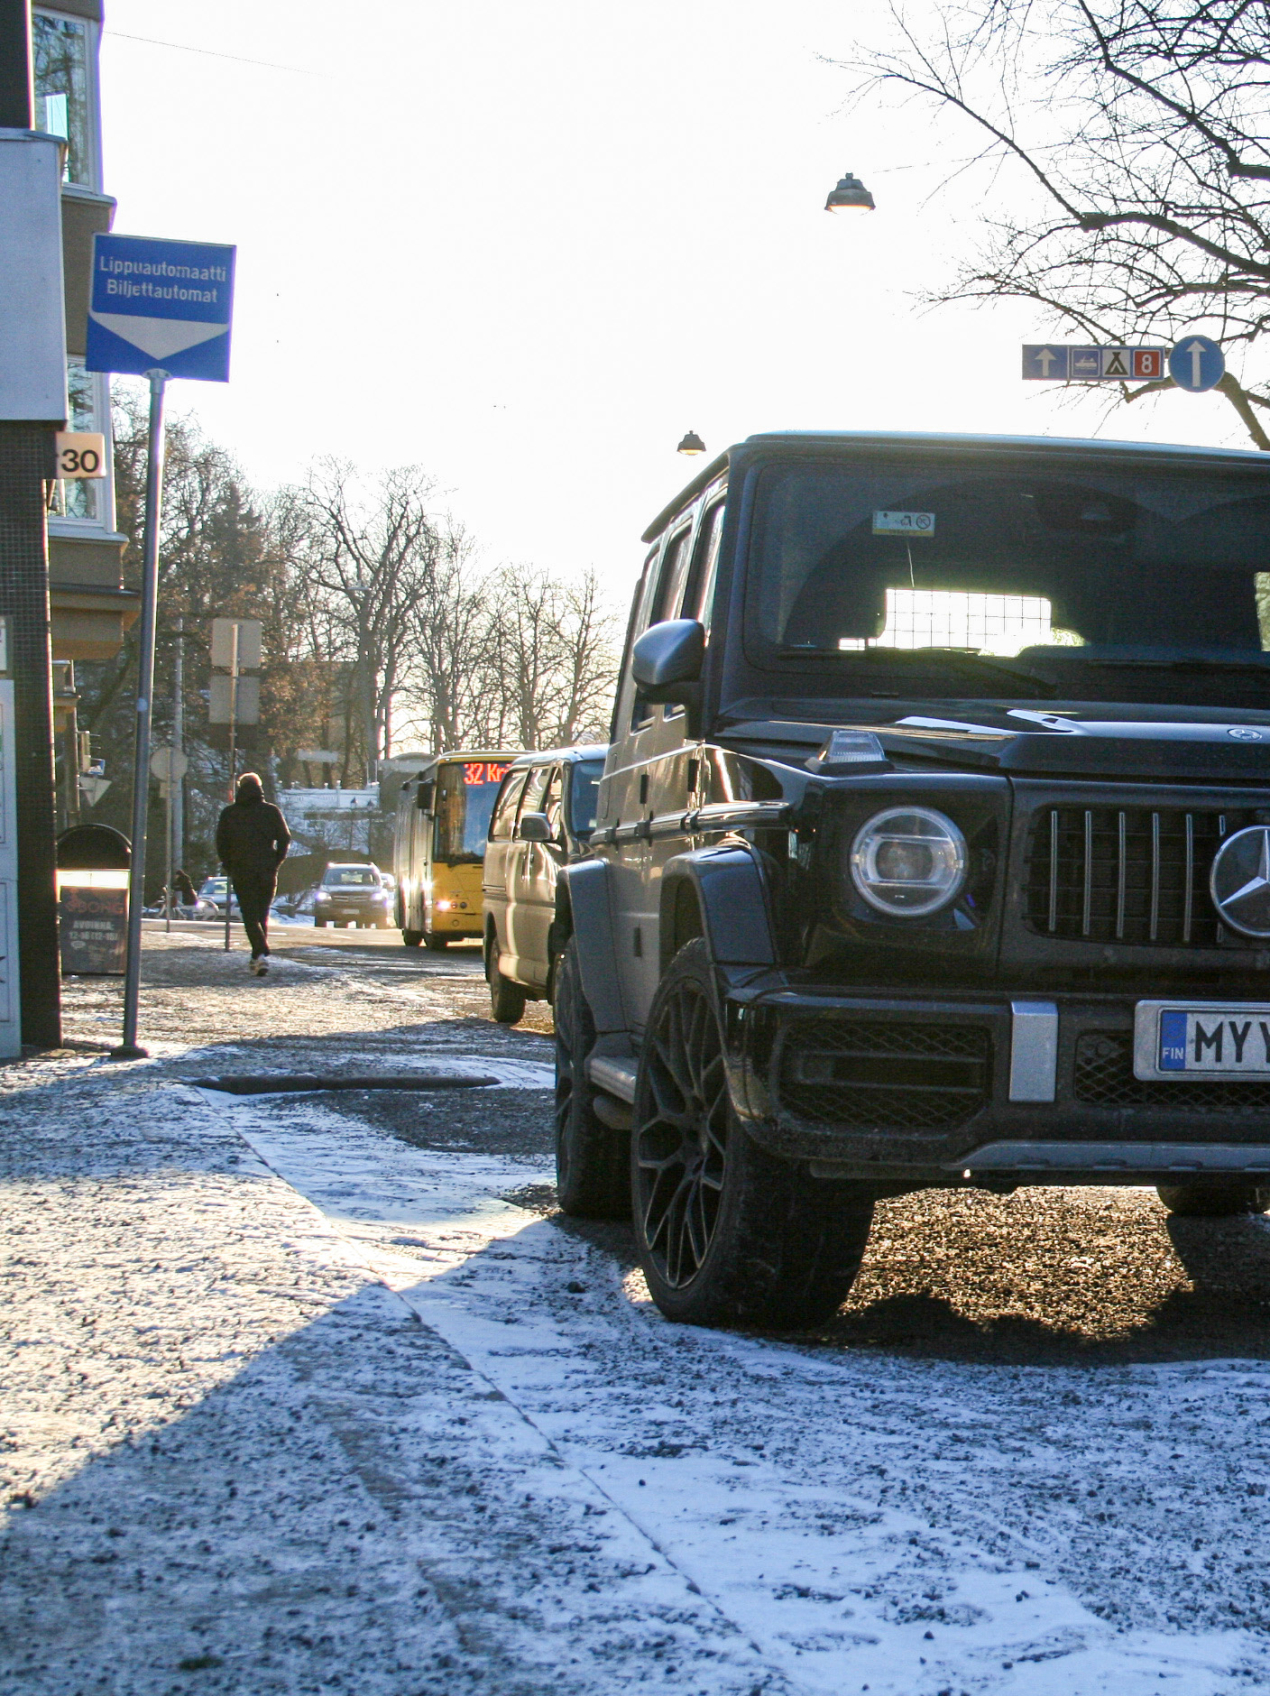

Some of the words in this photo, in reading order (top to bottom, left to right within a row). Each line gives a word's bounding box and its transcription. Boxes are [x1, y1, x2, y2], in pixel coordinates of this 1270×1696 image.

[99, 256, 227, 283] Lippuautomaatti
[106, 278, 219, 304] Biljettautomat
[1141, 354, 1153, 374] 8
[61, 449, 100, 474] 30
[463, 762, 485, 785] 32
[1161, 1046, 1185, 1061] FIN
